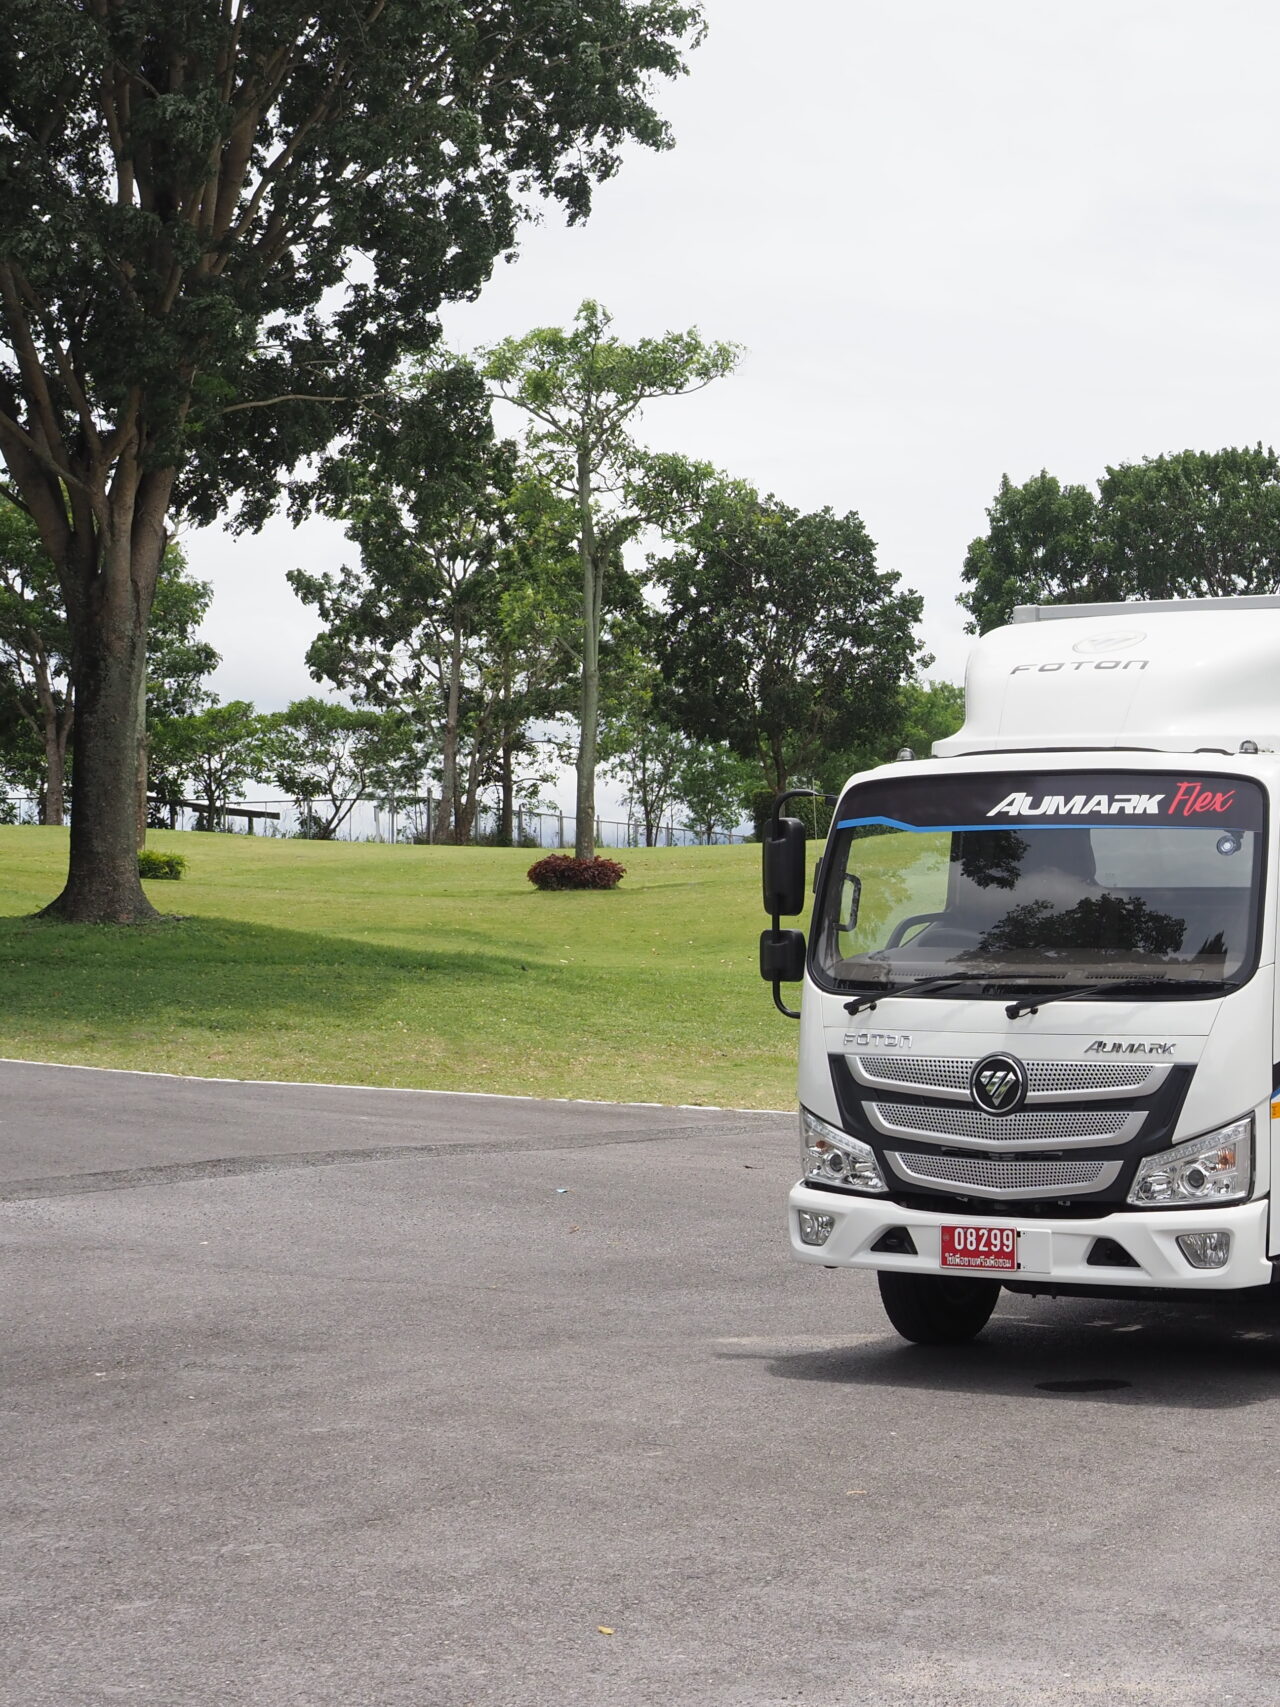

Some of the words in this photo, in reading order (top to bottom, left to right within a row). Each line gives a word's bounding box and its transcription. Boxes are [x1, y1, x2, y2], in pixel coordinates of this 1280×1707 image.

[1010, 660, 1149, 675] FOTON
[985, 792, 1166, 817] AUMARK
[1168, 781, 1236, 817] Flex
[843, 1033, 913, 1049] FOTON
[1083, 1040, 1177, 1055] AUMARK
[954, 1227, 1013, 1253] 08299
